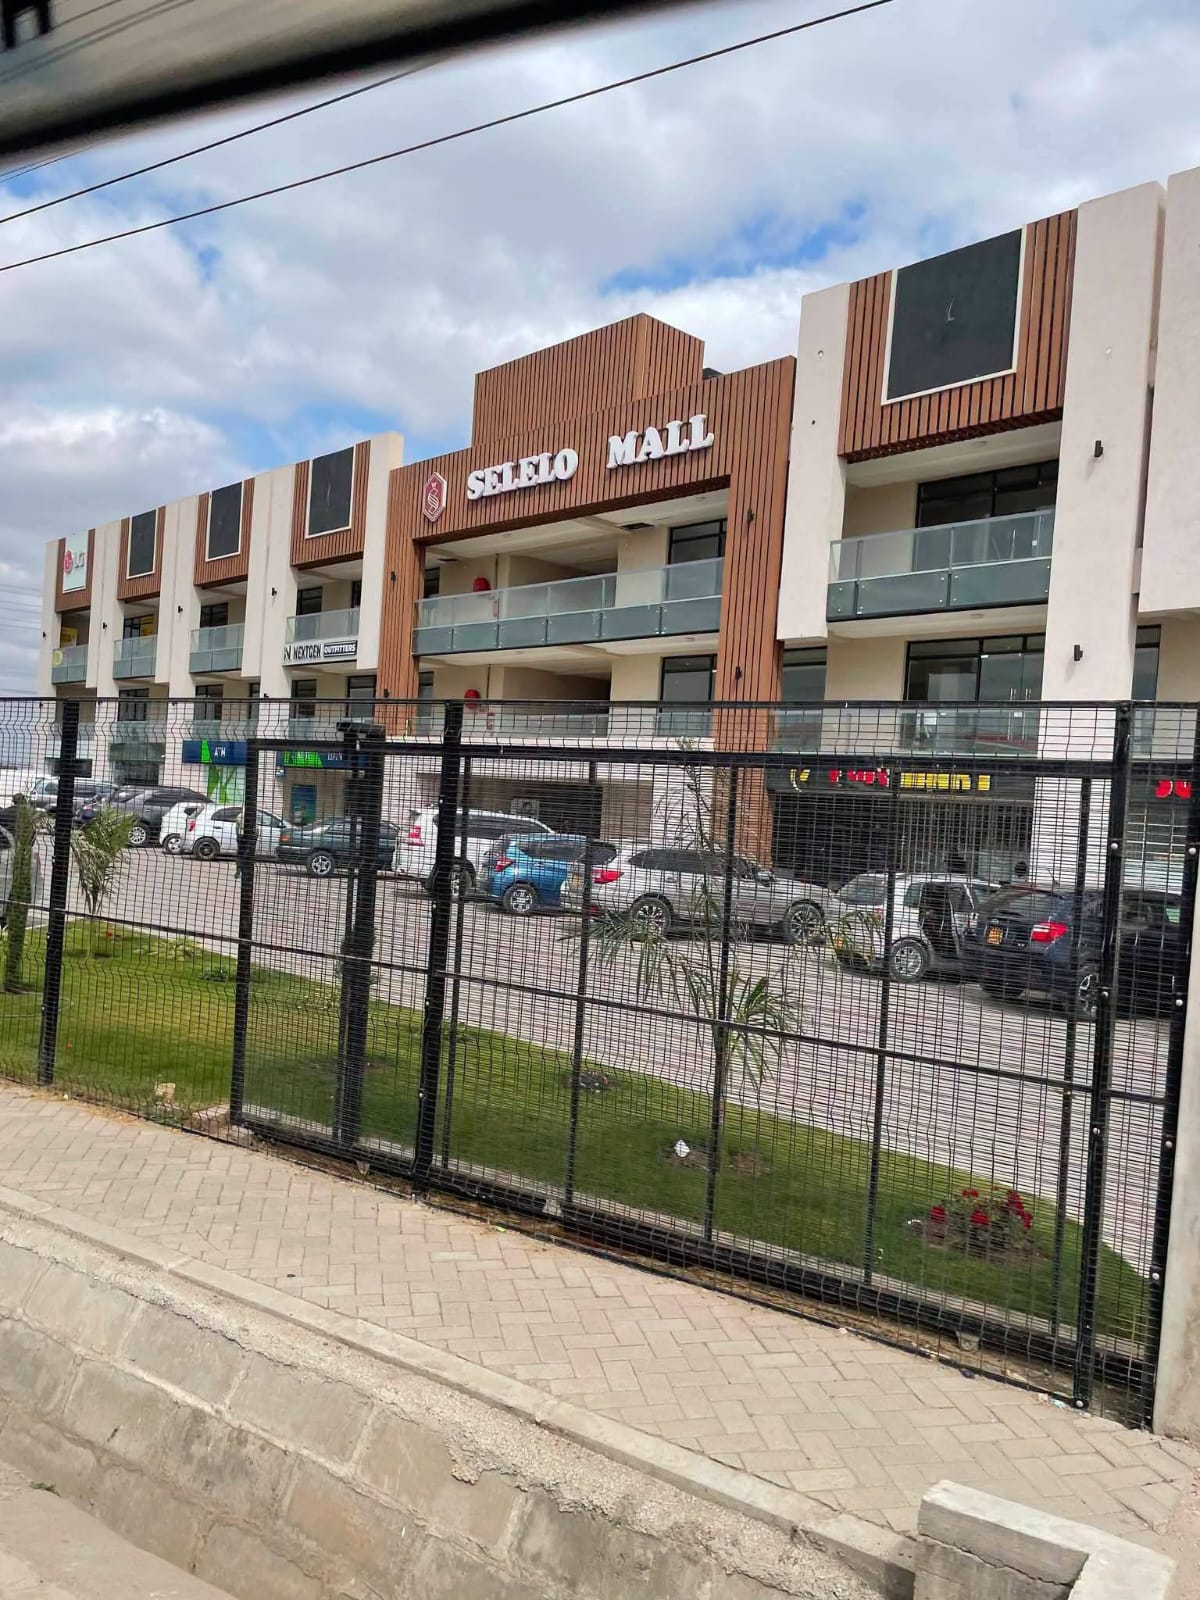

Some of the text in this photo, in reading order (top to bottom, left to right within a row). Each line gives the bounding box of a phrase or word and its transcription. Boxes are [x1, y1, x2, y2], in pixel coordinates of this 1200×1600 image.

[467, 414, 714, 499] SELELO MALL
[324, 644, 356, 654] OUTFITTERS
[214, 747, 226, 758] ATM
